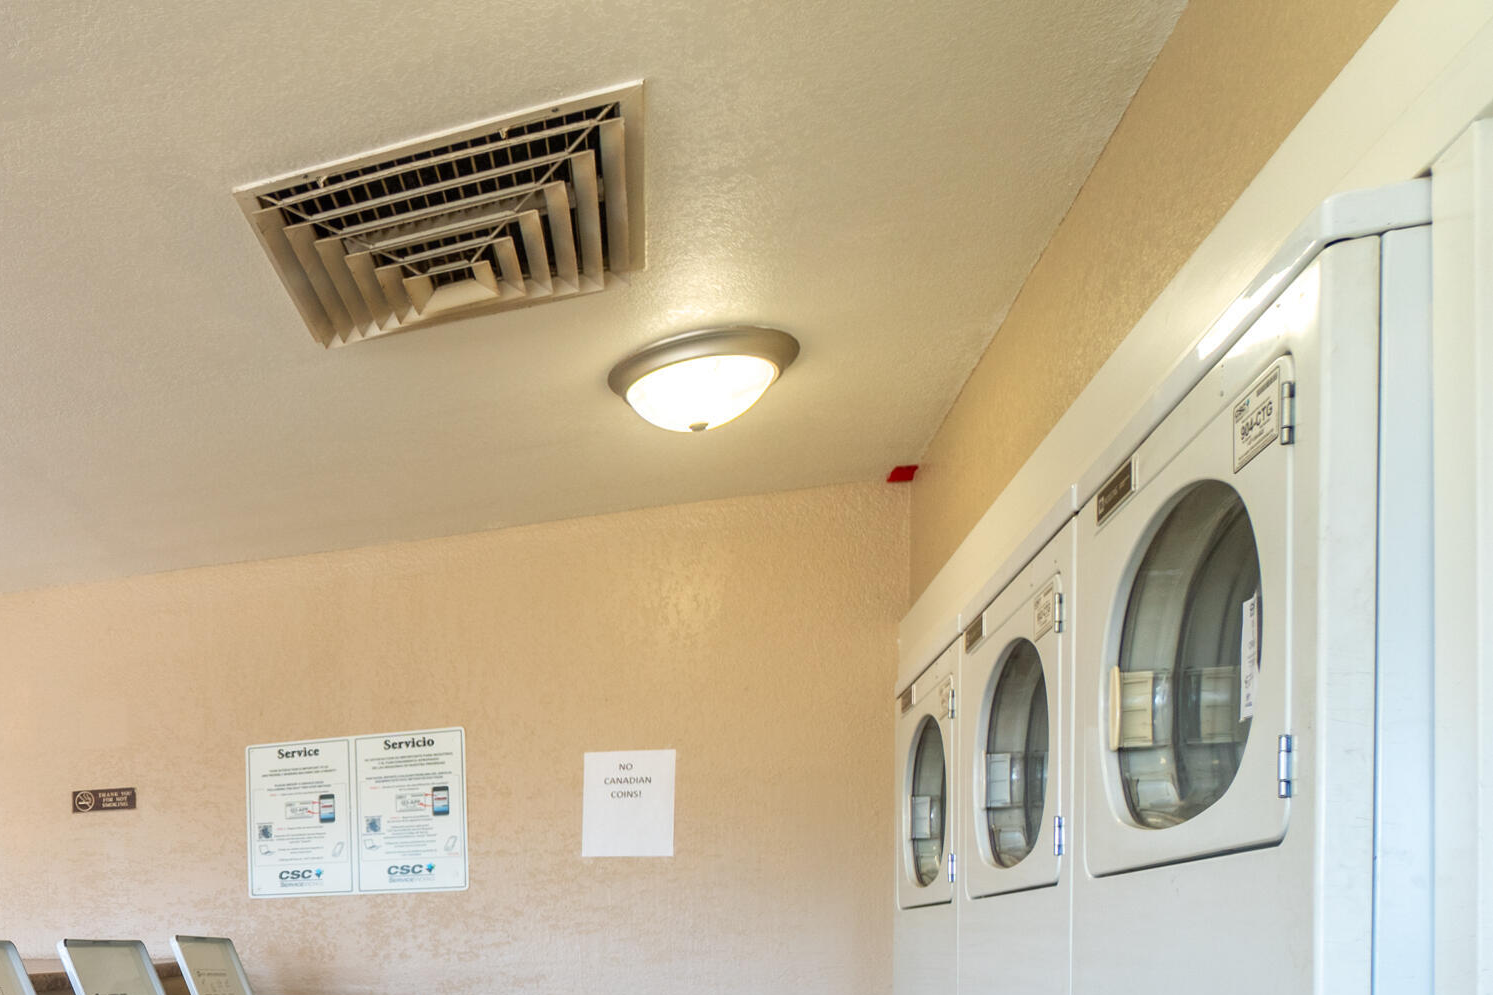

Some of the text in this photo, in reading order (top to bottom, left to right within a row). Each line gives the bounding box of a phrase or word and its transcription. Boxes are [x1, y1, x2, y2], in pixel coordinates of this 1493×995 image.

[1241, 401, 1272, 440] 904-CTG
[384, 737, 435, 750] Servicio
[277, 747, 320, 759] Service
[619, 763, 633, 771] NO
[604, 776, 652, 785] CANADIAN
[611, 790, 642, 799] COINS!
[279, 869, 313, 880] CSC
[388, 864, 423, 875] CSC
